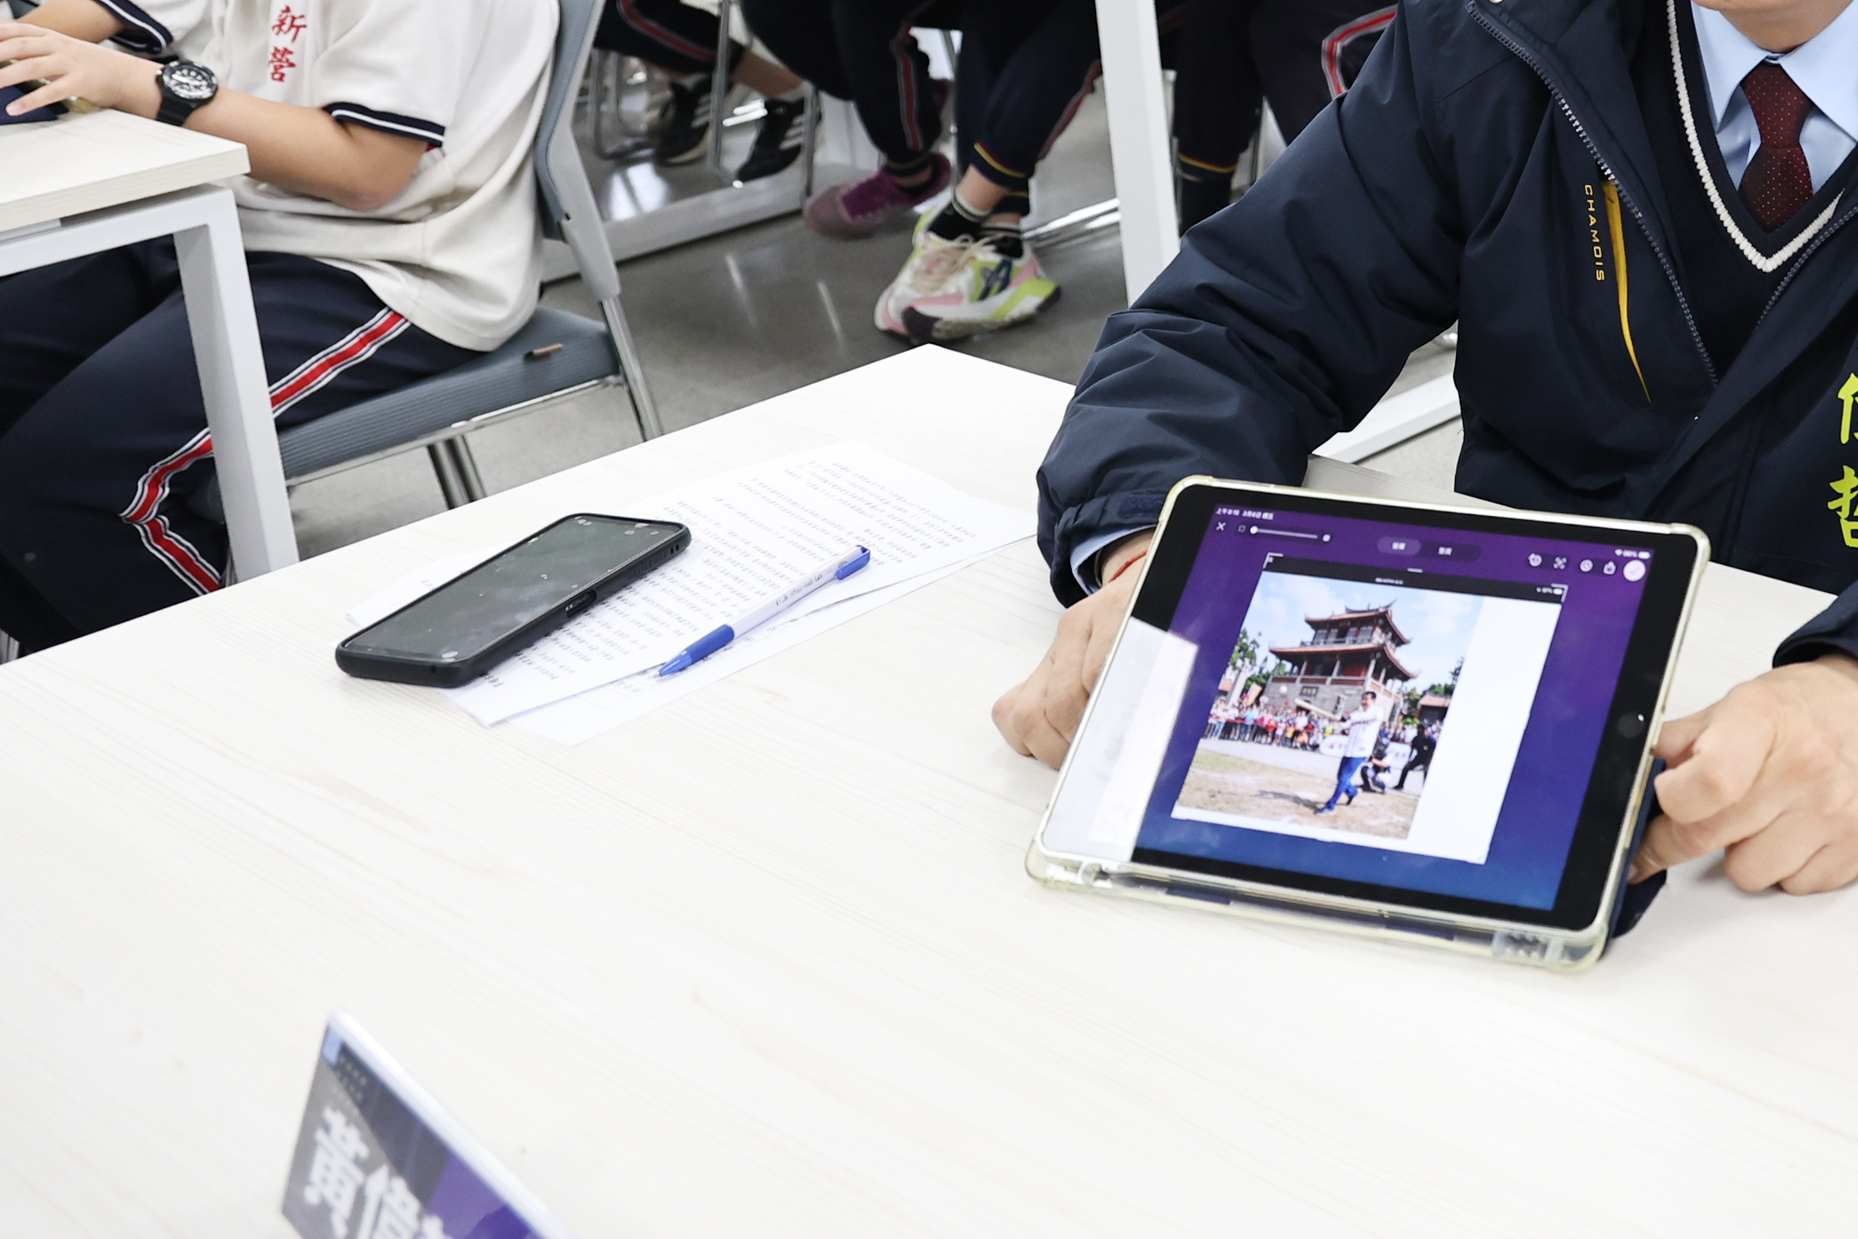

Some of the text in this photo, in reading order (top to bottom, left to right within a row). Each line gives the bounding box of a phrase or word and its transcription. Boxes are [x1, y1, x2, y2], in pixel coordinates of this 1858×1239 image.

[268, 5, 306, 82] 新營
[1584, 184, 1606, 281] CHAMOIS
[303, 1106, 455, 1239] 黃偉
